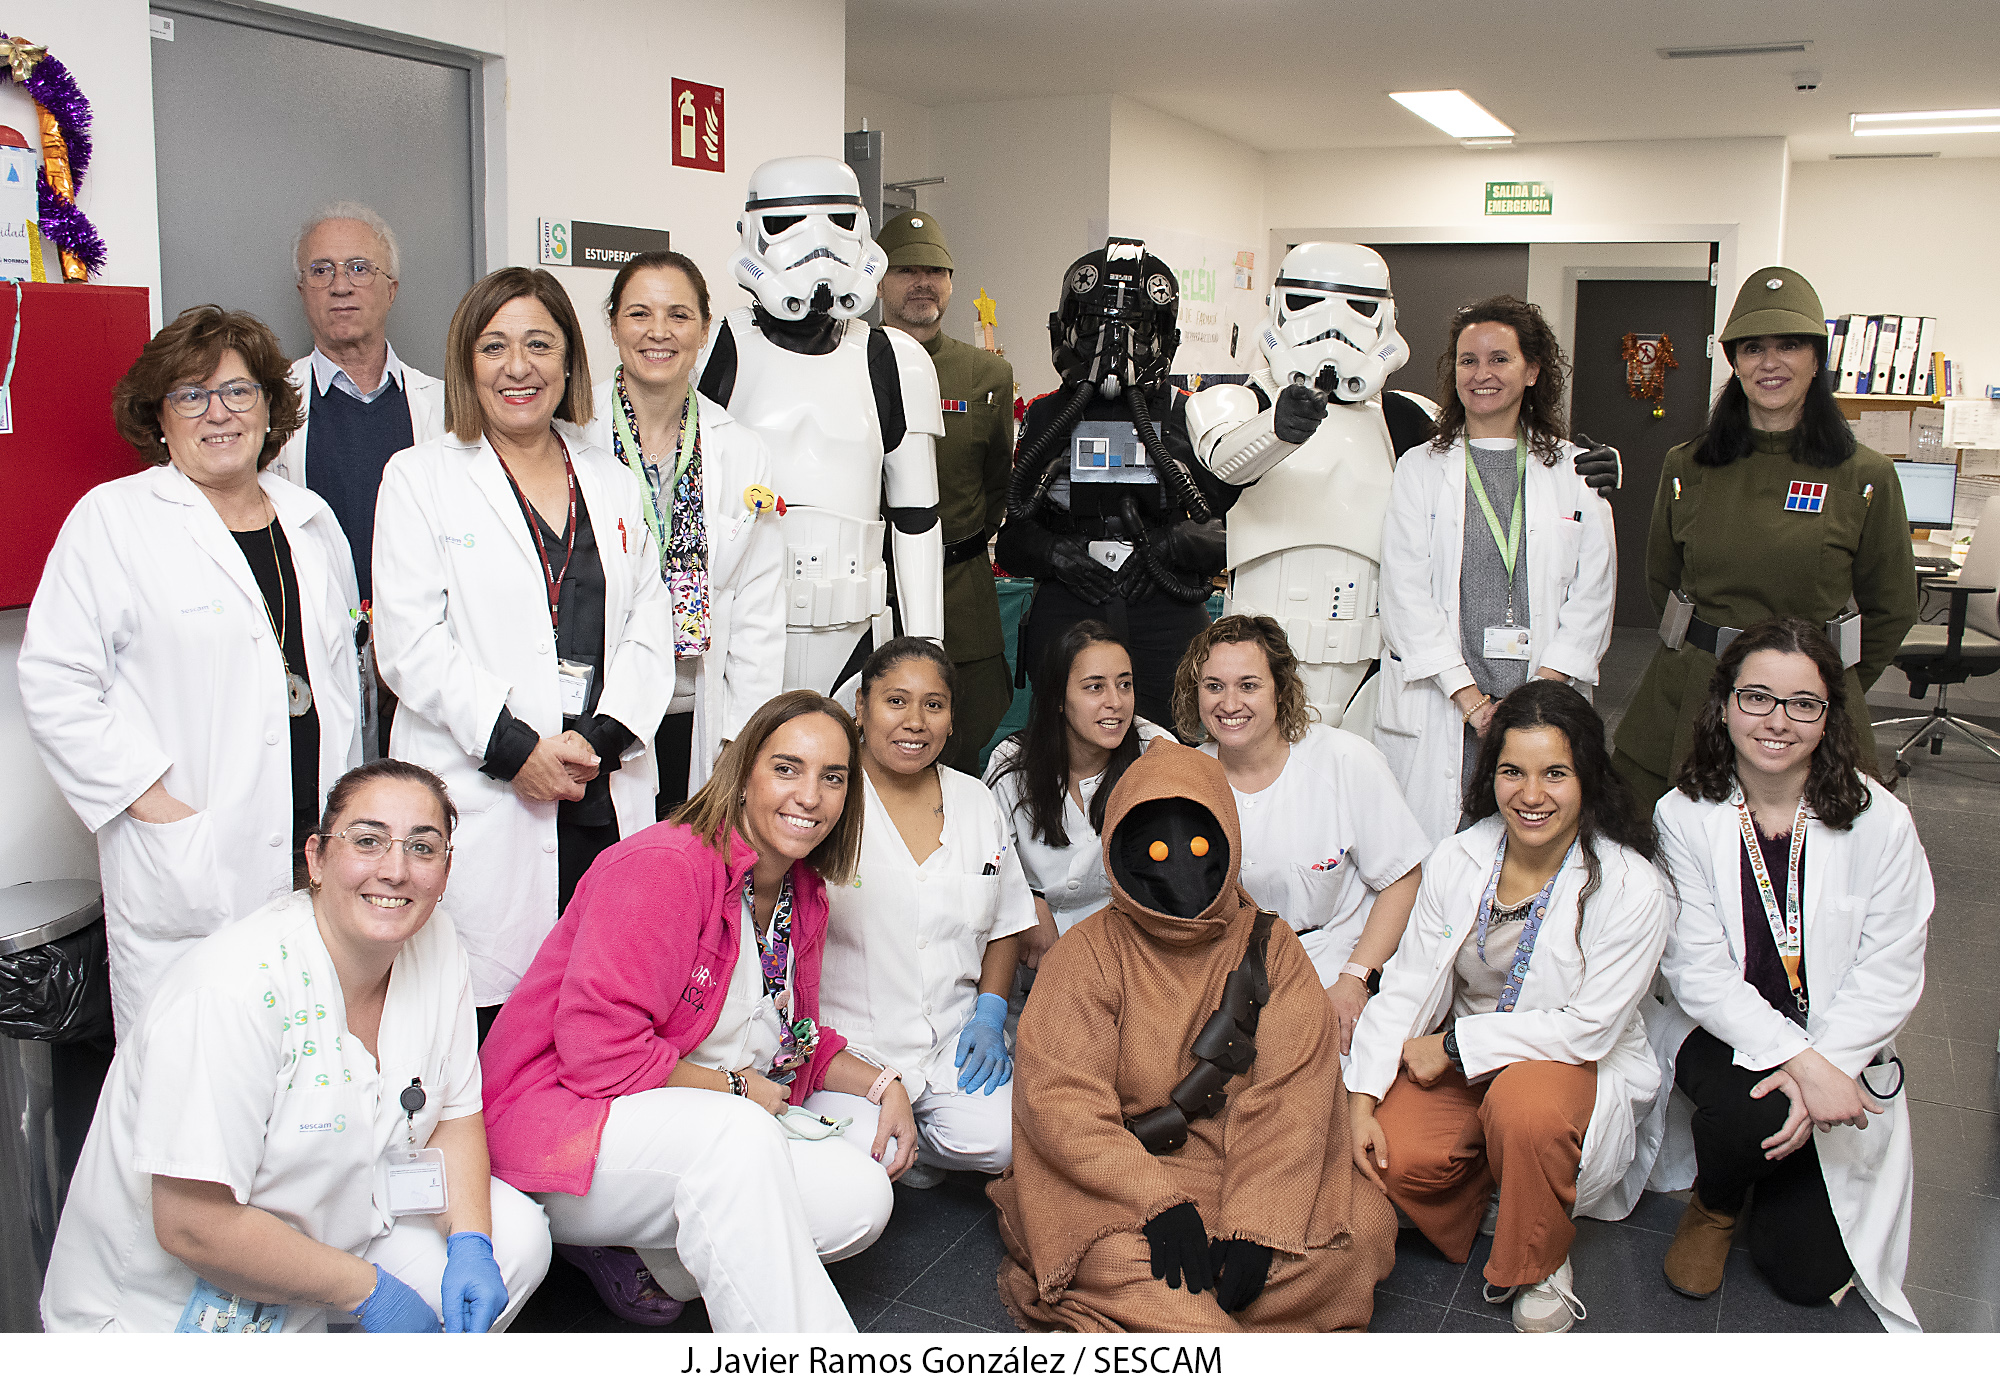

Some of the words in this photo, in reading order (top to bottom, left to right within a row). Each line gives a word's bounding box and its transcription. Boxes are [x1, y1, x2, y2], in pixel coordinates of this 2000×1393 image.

[1492, 185, 1529, 198] SALIDA
[1532, 185, 1546, 198] DE
[1487, 199, 1551, 213] EMERGENCIA
[543, 222, 551, 259] sescam
[3, 257, 29, 265] NORMON
[1738, 811, 1764, 871] FACULTATIVO
[1790, 811, 1808, 872] FACULTATIVO
[299, 1122, 332, 1130] sescam
